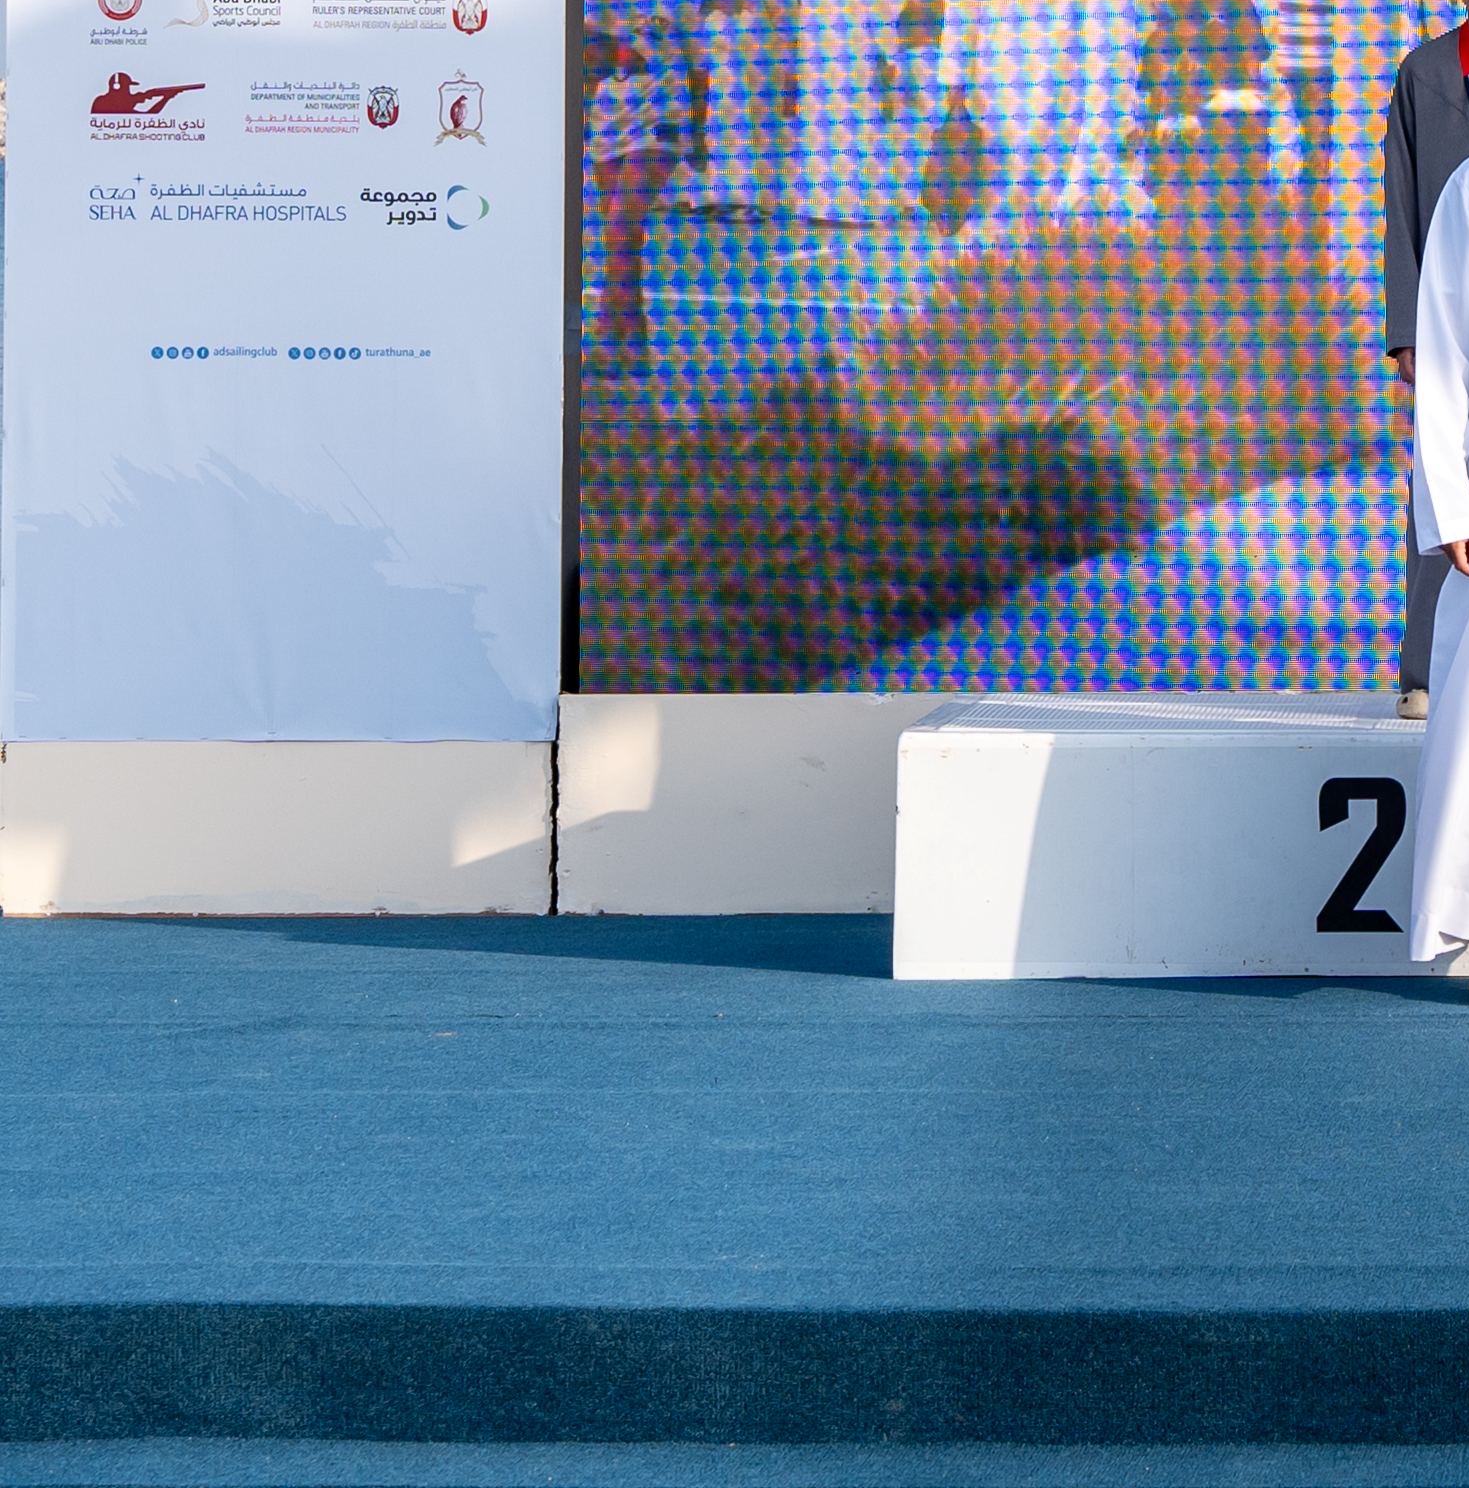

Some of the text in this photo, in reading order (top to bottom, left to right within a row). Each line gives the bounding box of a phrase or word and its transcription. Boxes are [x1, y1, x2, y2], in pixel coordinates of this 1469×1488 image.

[212, 5, 281, 18] Sports Council
[347, 6, 417, 15] REPRESENTATIVE
[418, 6, 446, 16] COURT
[250, 93, 296, 101] DEPARTMENT
[296, 93, 306, 101] OF
[320, 103, 360, 111] TRANSPORT
[149, 182, 307, 201] مستشفيات الظفرة
[360, 188, 437, 207] مجموعة
[88, 204, 137, 221] SEHA
[150, 204, 347, 222] AL DHAFRA HOSPITALS
[386, 207, 437, 226] تدوير
[212, 346, 278, 359] adsailingclub
[365, 347, 432, 359] turathuna_ae
[1315, 776, 1408, 934] 2
